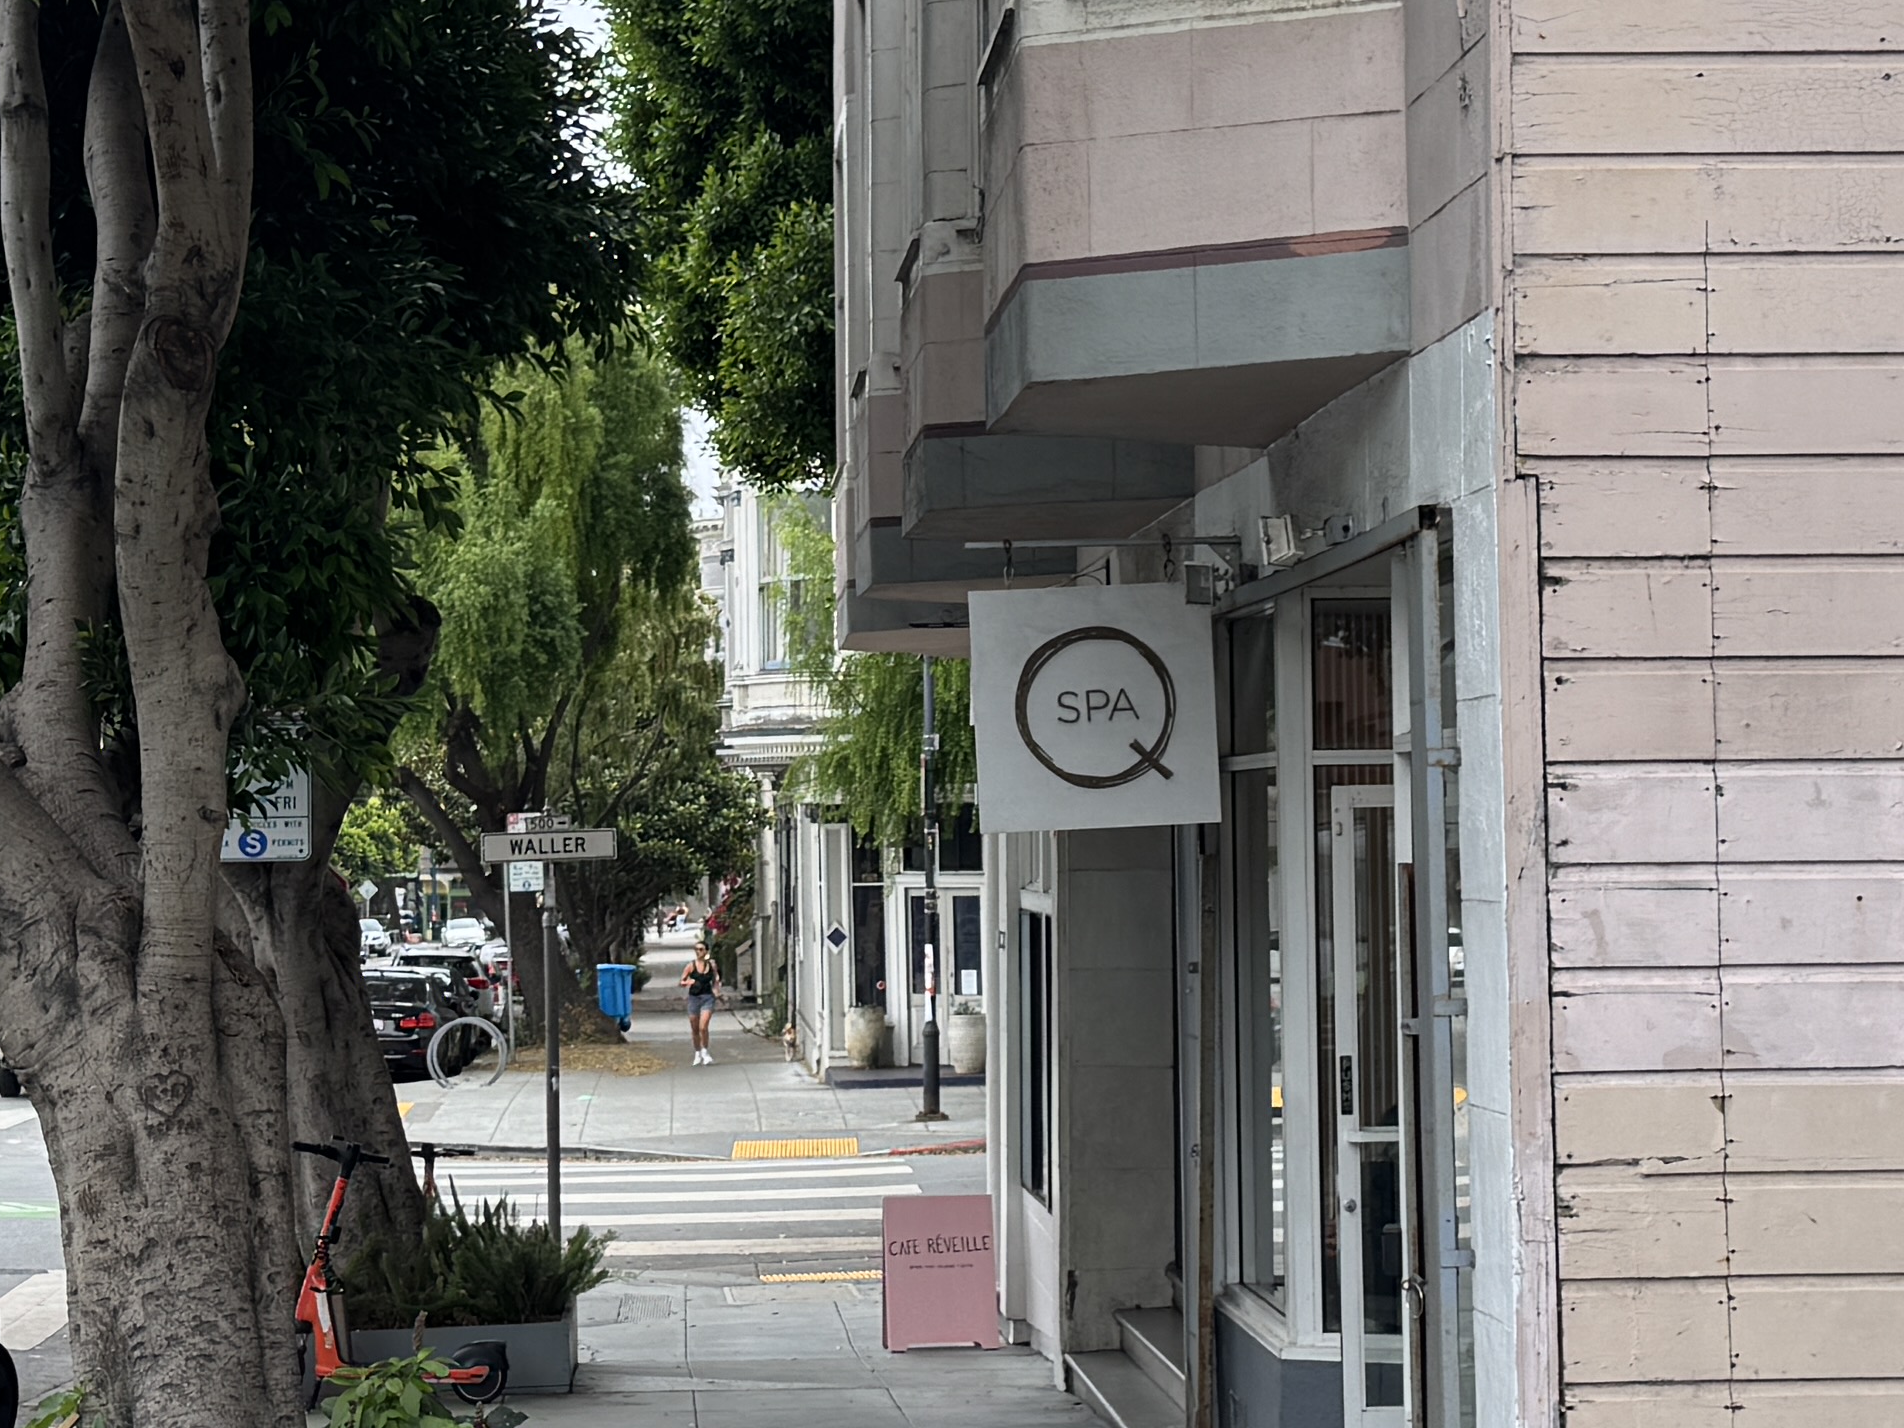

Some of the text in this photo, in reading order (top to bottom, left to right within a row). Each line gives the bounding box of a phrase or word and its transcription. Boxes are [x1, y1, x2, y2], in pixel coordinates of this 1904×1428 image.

[1057, 688, 1140, 724] SPA
[275, 796, 296, 809] FRI
[272, 839, 304, 847] PERMITS
[510, 836, 586, 856] WALLER
[889, 1233, 990, 1256] CAFE RÉVEILLE
